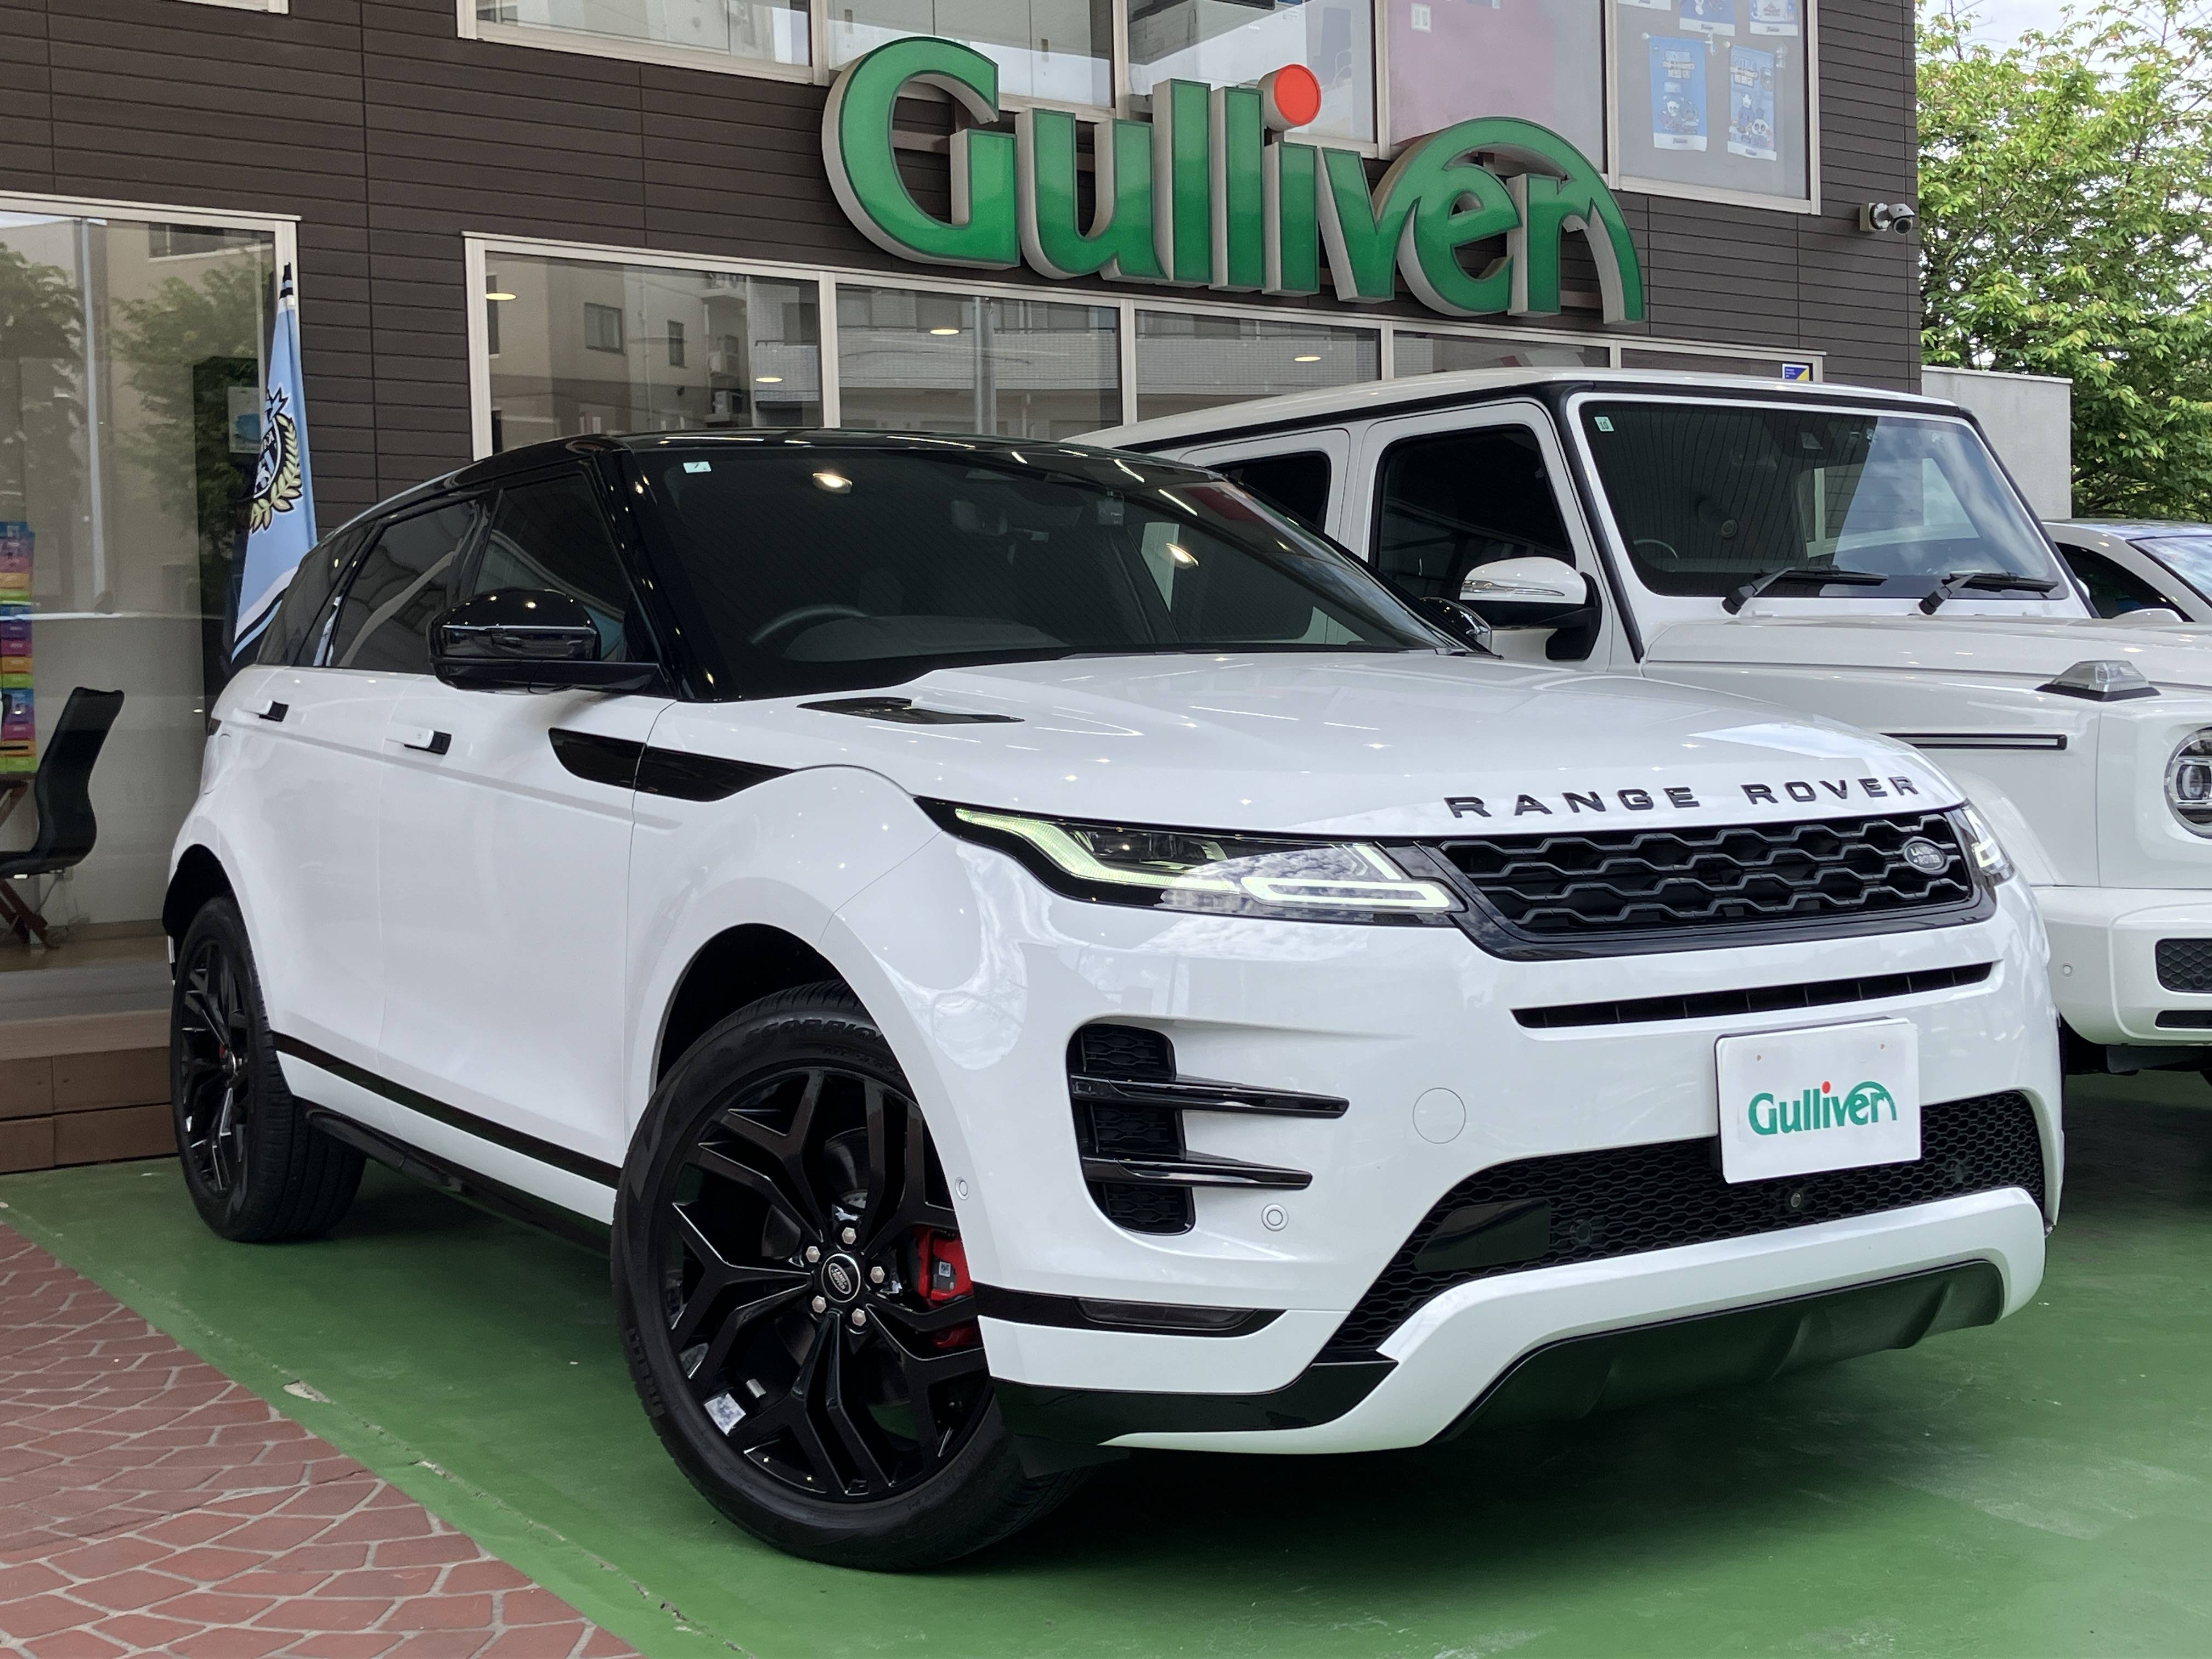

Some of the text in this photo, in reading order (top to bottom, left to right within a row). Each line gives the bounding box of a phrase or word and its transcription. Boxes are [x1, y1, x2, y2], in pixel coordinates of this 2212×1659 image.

[822, 36, 1645, 324] Gulliver
[1444, 776, 1918, 818] RANGE ROVER
[1748, 1080, 1898, 1136] Gulliver
